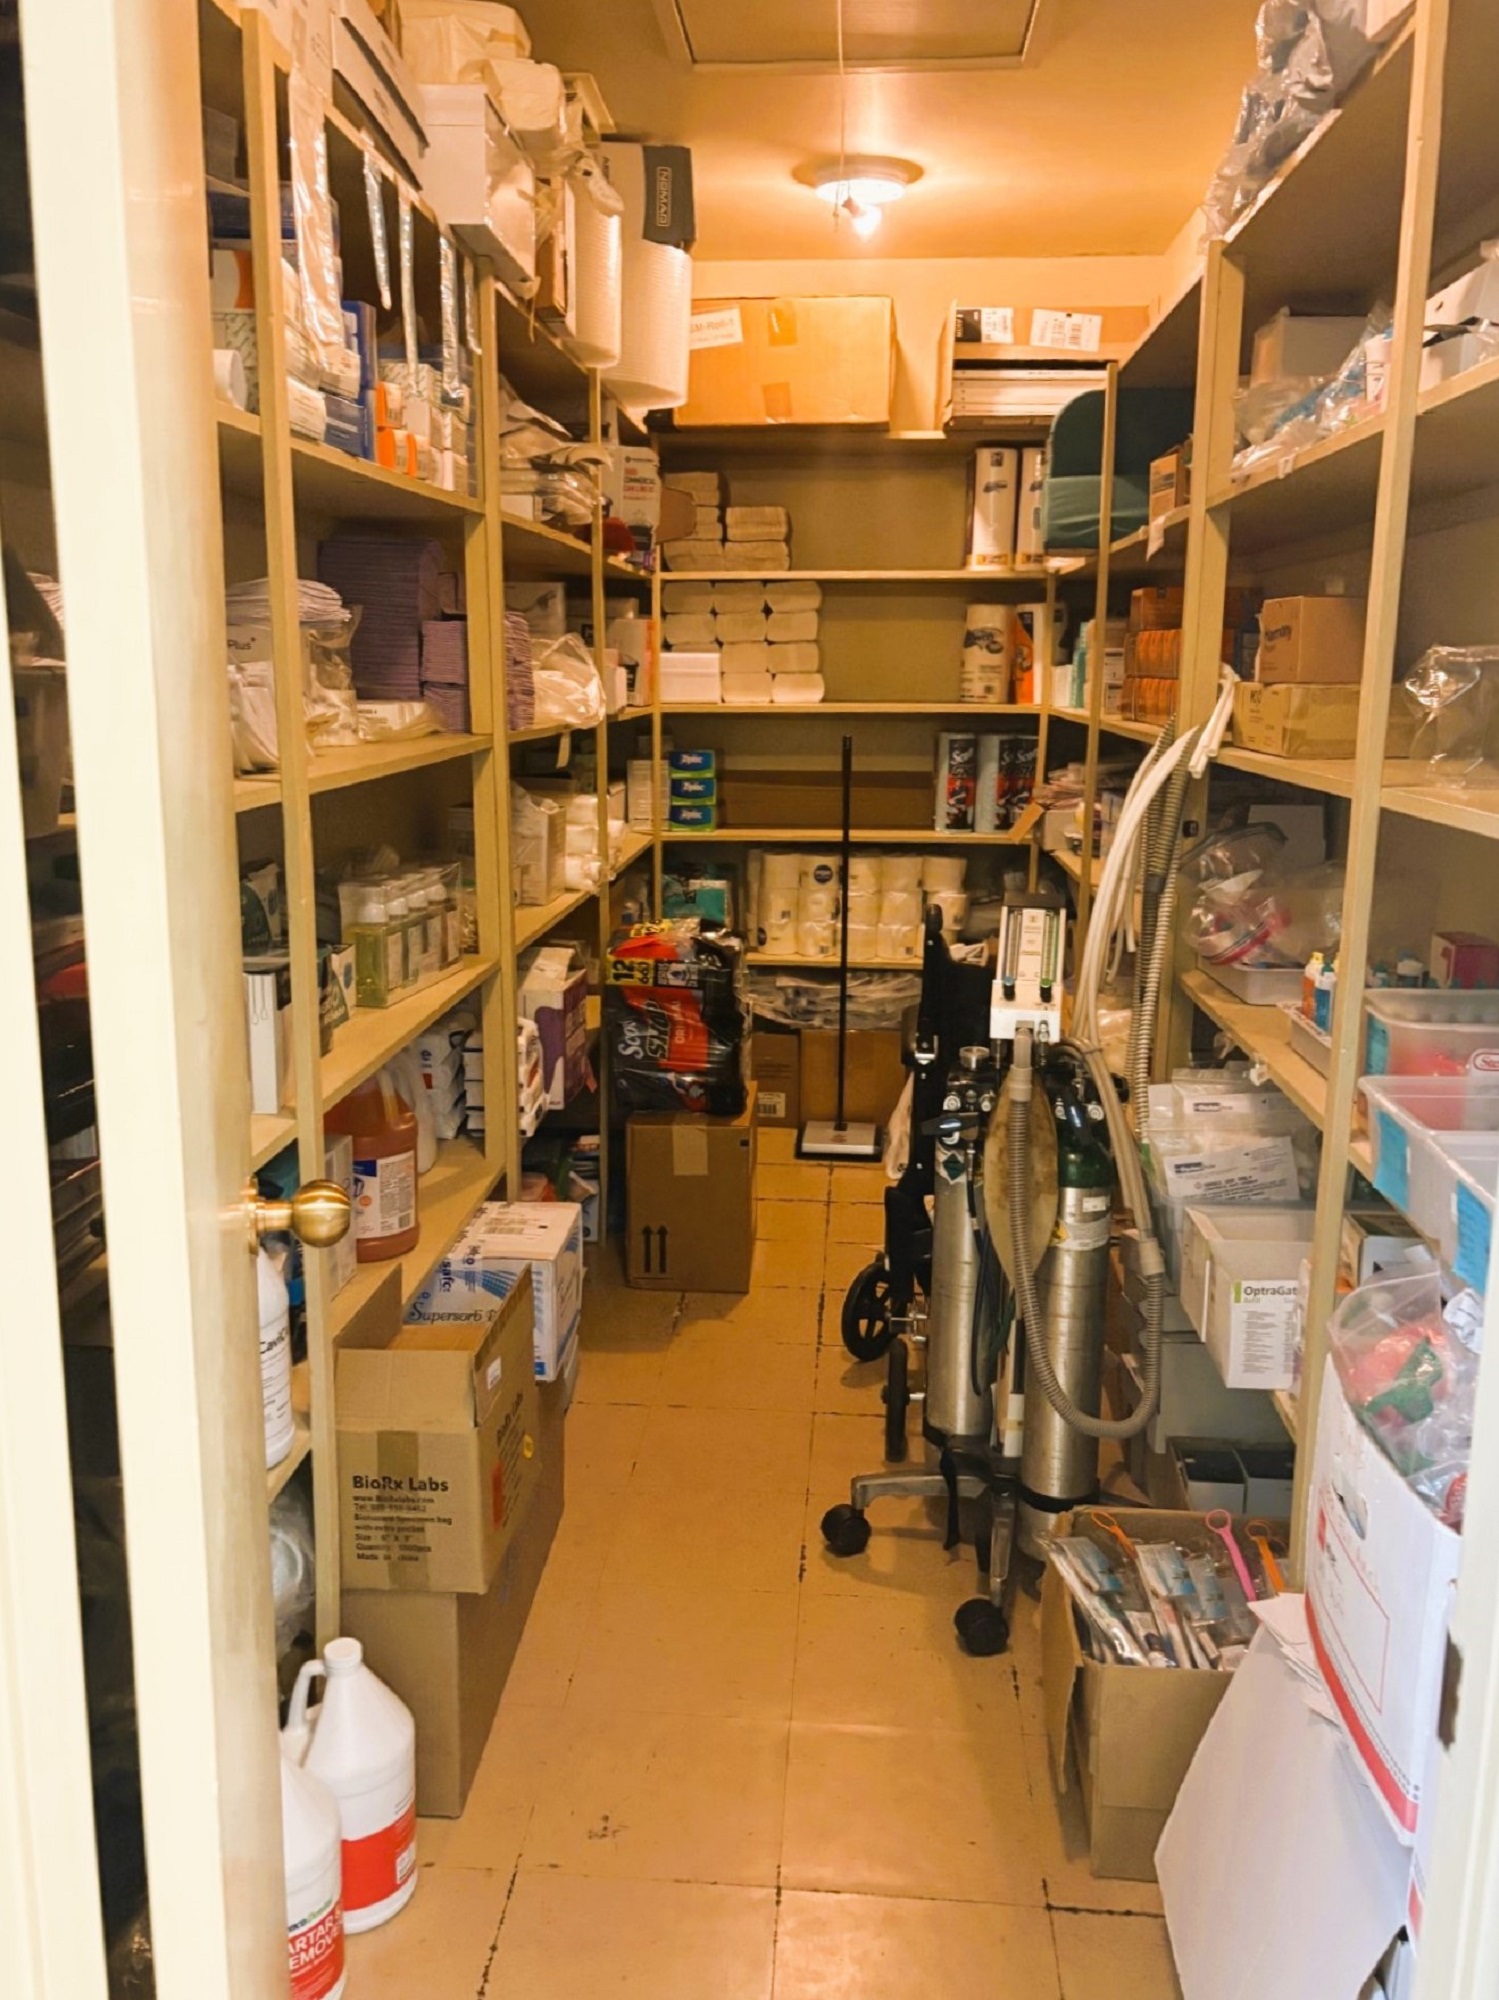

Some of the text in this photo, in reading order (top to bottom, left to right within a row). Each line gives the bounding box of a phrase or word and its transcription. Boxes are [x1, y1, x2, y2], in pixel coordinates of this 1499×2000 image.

[658, 167, 670, 225] NOMAD
[1243, 1286, 1297, 1297] OptraGat
[352, 1475, 449, 1492] BioRx Labs
[287, 1915, 335, 1955] ARTAR
